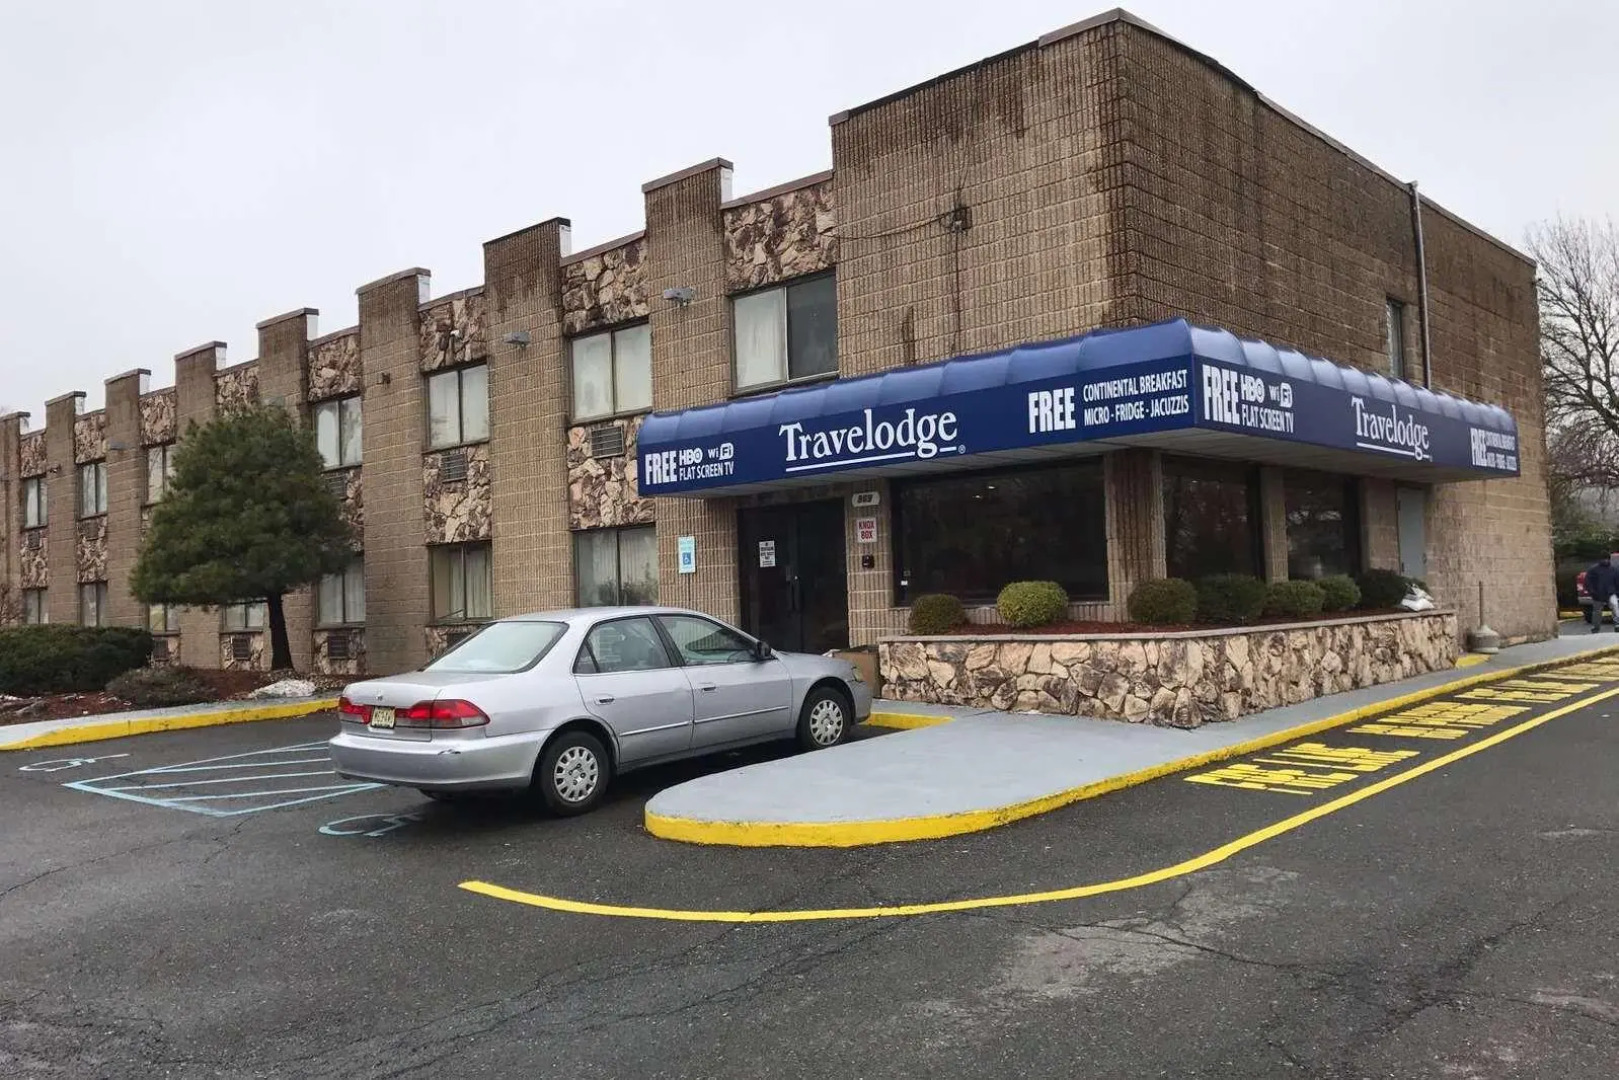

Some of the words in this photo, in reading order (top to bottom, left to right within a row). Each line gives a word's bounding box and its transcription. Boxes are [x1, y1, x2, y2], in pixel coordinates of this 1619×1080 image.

[1083, 381, 1138, 402] CONTINENTAL
[1140, 369, 1187, 396] BREAKFAST
[1202, 364, 1240, 425] FREE
[1240, 374, 1265, 403] HBO
[1028, 387, 1076, 434] FREE
[1084, 406, 1110, 426] MICRO
[1115, 400, 1145, 422] FRIDGE
[1150, 395, 1189, 418] JACUZZIS
[1242, 404, 1259, 428] FLAT
[1260, 407, 1286, 432] SCREEN
[1285, 412, 1294, 433] TV
[779, 408, 957, 458] Travelodge
[1351, 395, 1430, 461] Travelodge
[645, 450, 678, 485] FREE
[679, 447, 703, 466] HBO
[680, 466, 696, 481] FLAT
[697, 463, 723, 479] SCREEN
[724, 461, 734, 476] TV
